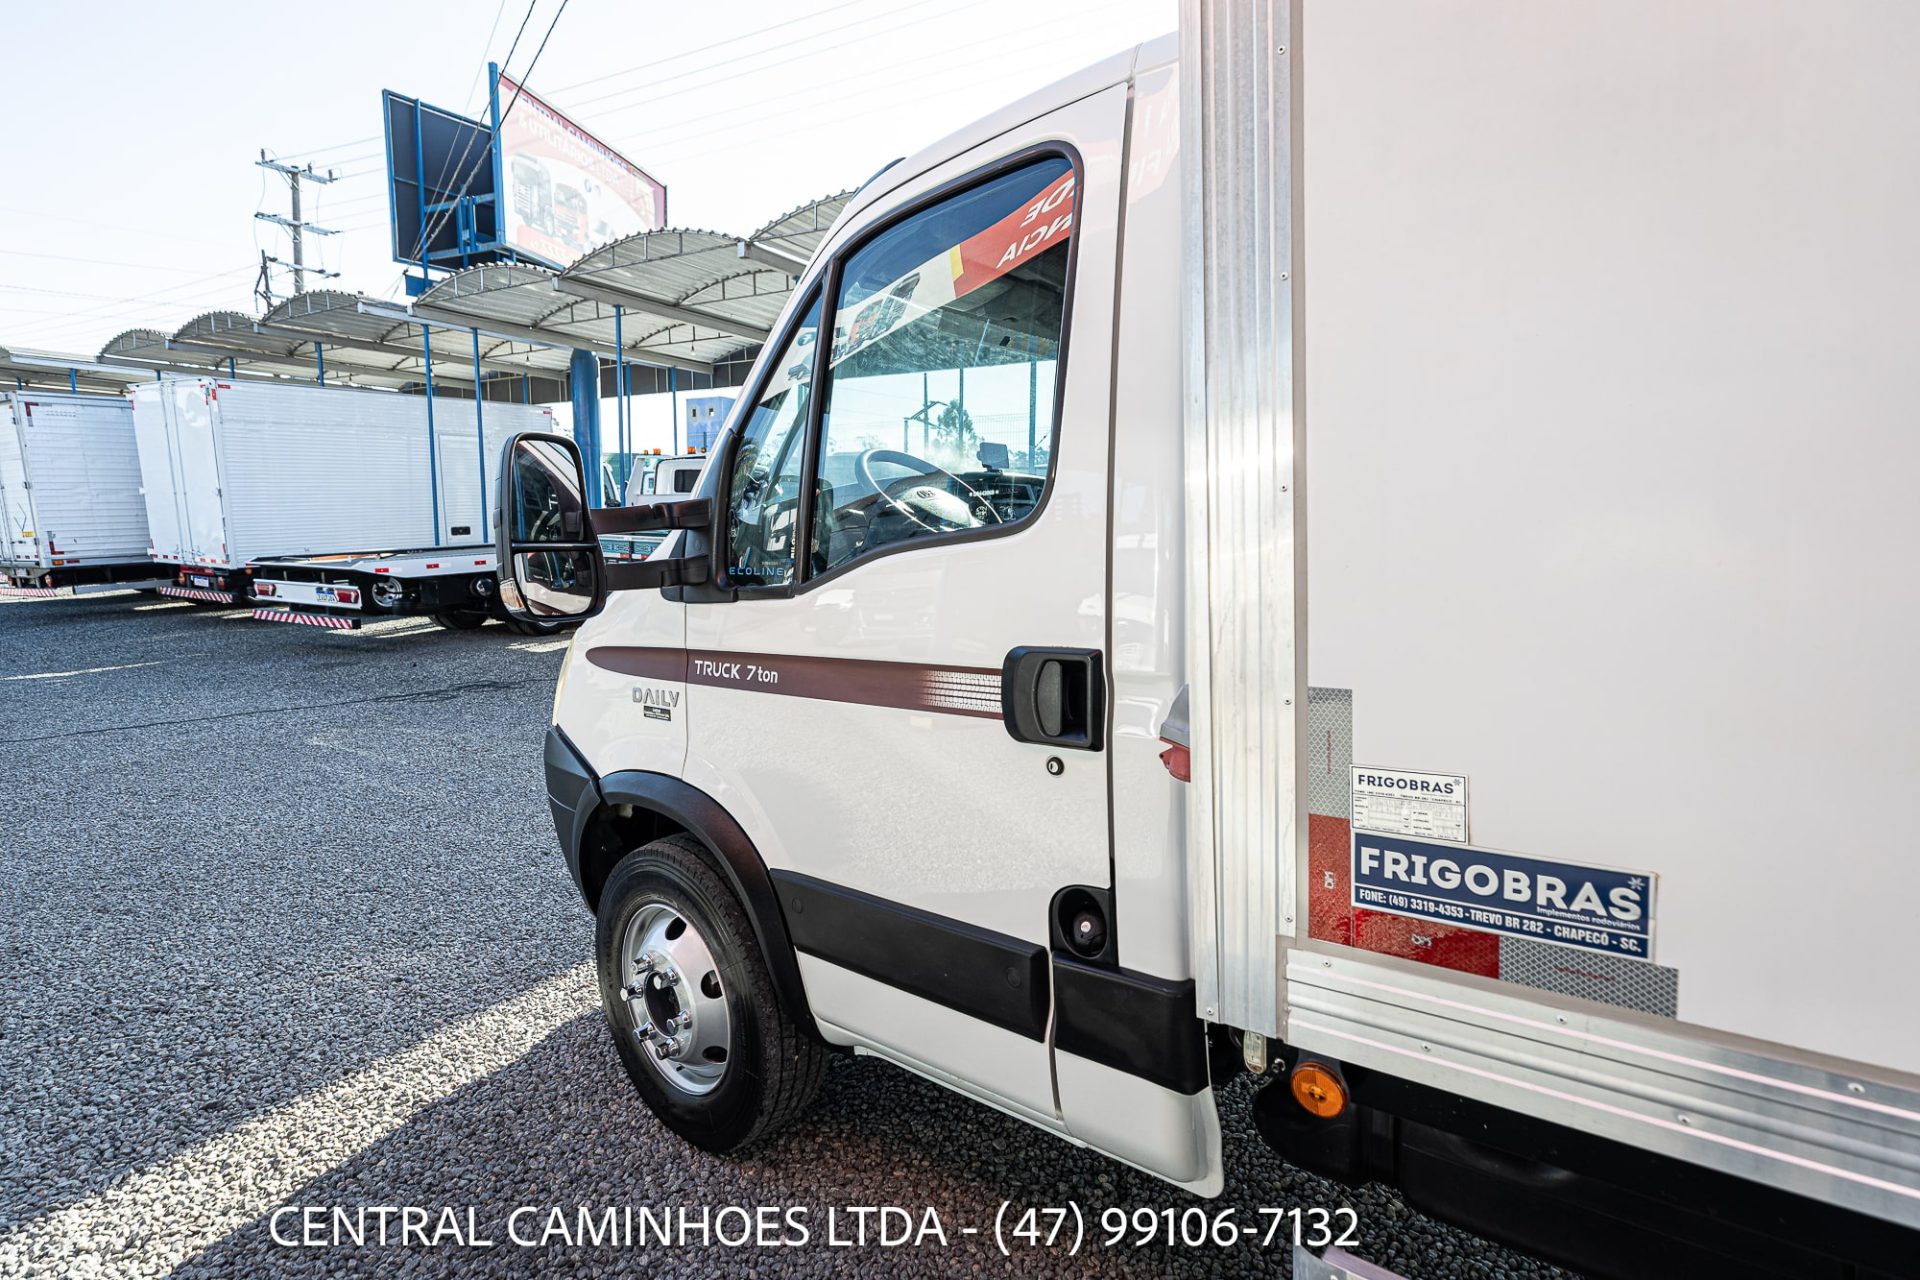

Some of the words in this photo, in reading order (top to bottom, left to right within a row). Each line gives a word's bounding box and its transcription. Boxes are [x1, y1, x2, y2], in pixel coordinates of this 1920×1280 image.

[728, 566, 784, 576] ECOLINE
[694, 659, 741, 680] TRUCK
[746, 665, 778, 683] 7ton
[632, 686, 680, 707] DAILY
[1358, 774, 1454, 794] FRIGOBRAS
[1360, 846, 1642, 921] FRIGOBRAS
[1359, 888, 1387, 903] FONE:
[1388, 894, 1408, 909] (49)
[1505, 916, 1520, 929] BR
[1522, 919, 1544, 934] 282
[1553, 925, 1609, 946] CHAPECÓ
[1537, 906, 1590, 923] Implementos
[1592, 916, 1641, 931] rodoviários
